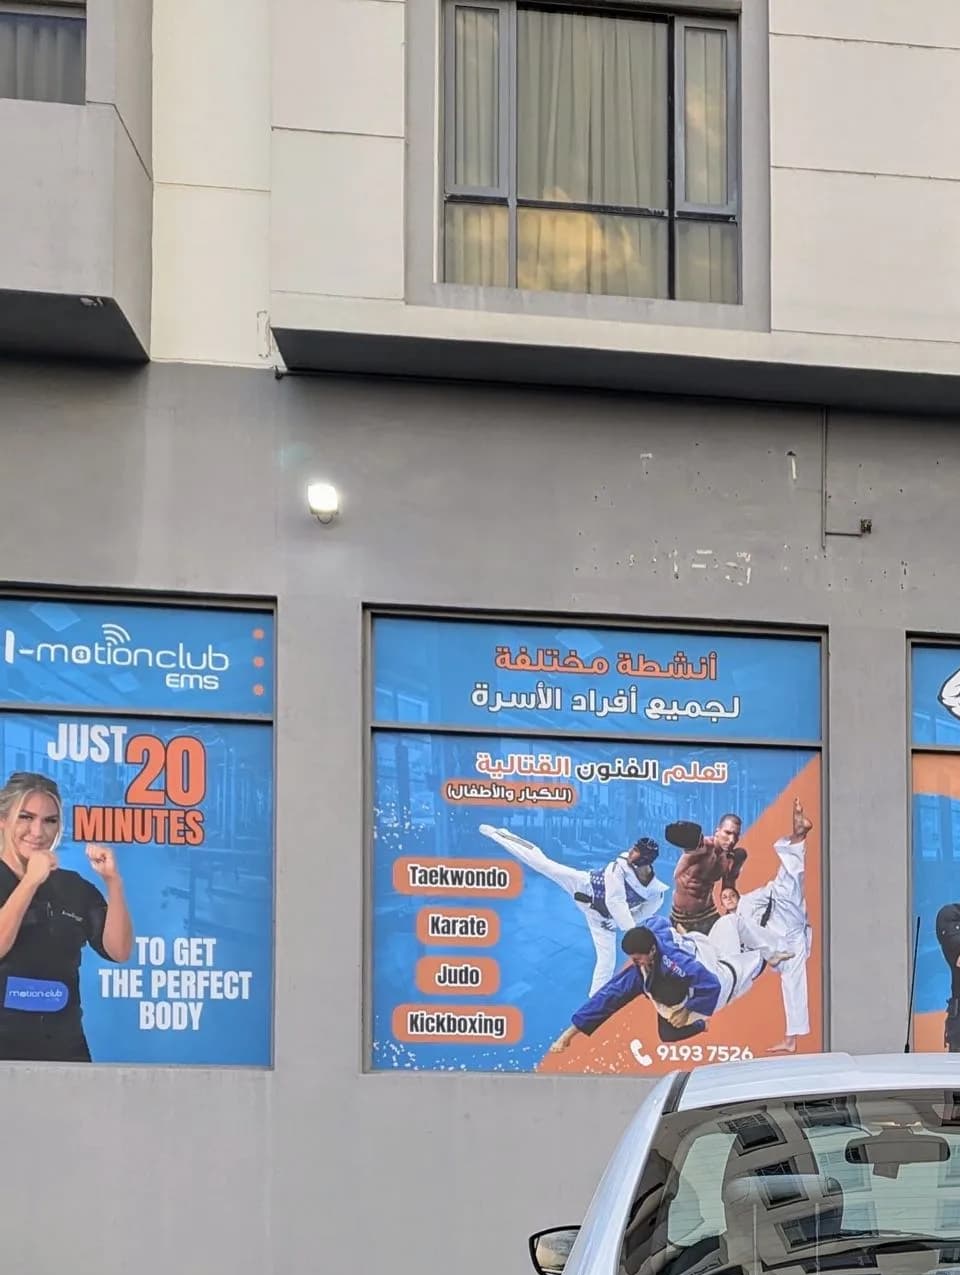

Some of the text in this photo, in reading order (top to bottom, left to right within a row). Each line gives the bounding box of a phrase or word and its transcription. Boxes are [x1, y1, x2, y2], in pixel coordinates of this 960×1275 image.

[494, 646, 718, 681] أنشطة مختلفة
[470, 682, 741, 723] لجميع أفراد الأسرة
[47, 723, 207, 807] JUST 20
[475, 752, 729, 786] تعلم الفنون القتالية
[72, 805, 205, 846] MINUTES
[408, 864, 509, 888] Taekwondo
[429, 914, 488, 937] Karate
[136, 936, 216, 967] TO GET
[98, 969, 252, 1000] THE PERFECT
[436, 965, 481, 986] Judo
[139, 1001, 203, 1031] BODY
[408, 1012, 506, 1037] Kickboxing
[656, 1045, 754, 1062] 9193 7526
